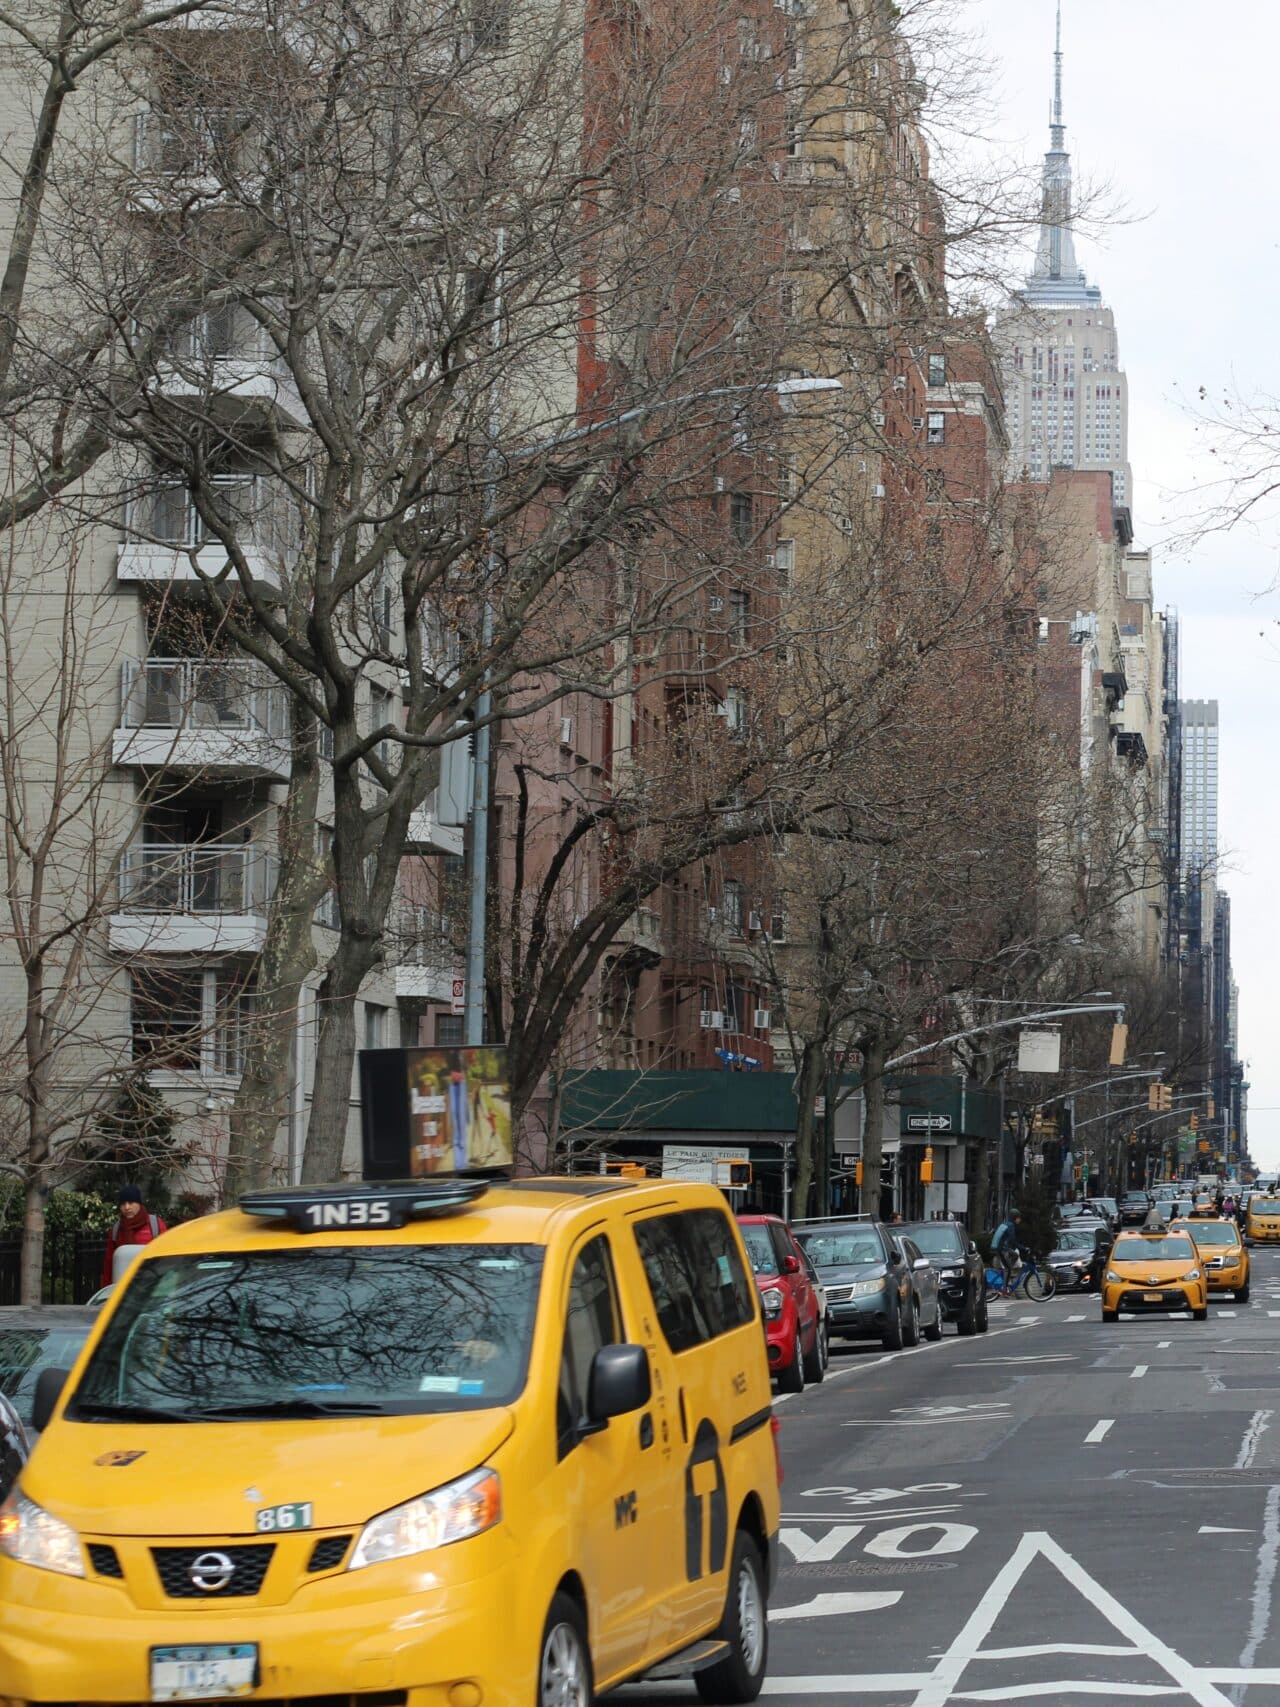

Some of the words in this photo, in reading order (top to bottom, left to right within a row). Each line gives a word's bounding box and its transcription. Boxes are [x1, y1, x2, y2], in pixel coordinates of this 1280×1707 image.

[680, 1150, 698, 1158] PAIN
[305, 1201, 391, 1226] 1N35
[256, 1502, 312, 1531] 861
